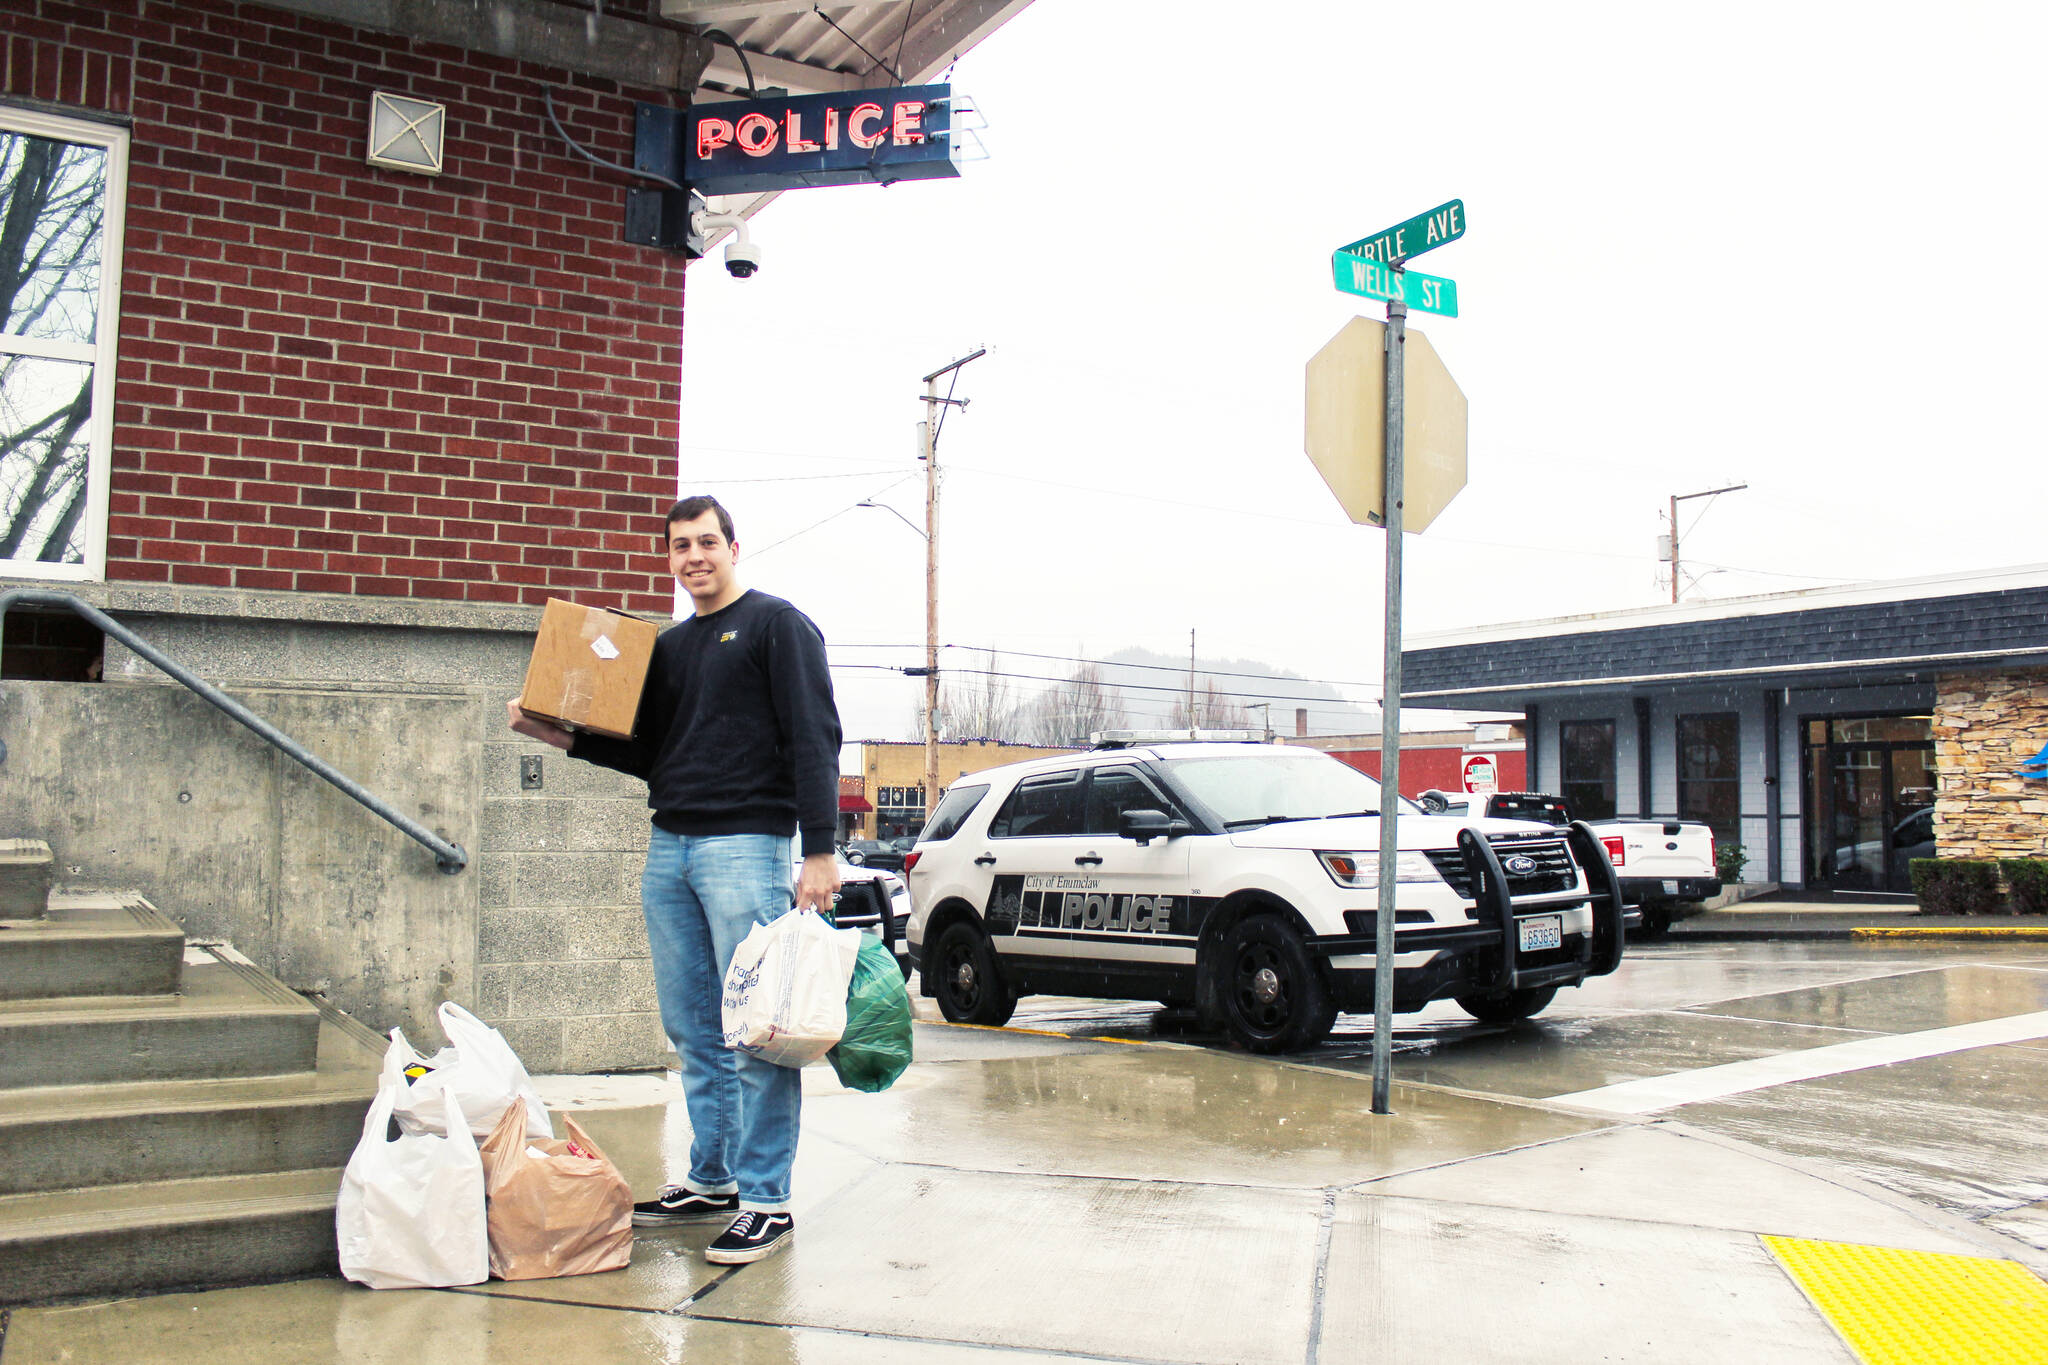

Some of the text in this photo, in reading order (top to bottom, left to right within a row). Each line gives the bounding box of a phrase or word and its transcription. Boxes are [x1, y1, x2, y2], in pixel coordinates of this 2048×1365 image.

[697, 101, 926, 160] POLICE
[1346, 205, 1462, 263] RTLE AVE
[1352, 261, 1442, 309] WELLS ST
[1026, 875, 1100, 890] City of Enumclaw
[1063, 894, 1173, 931] POLICE
